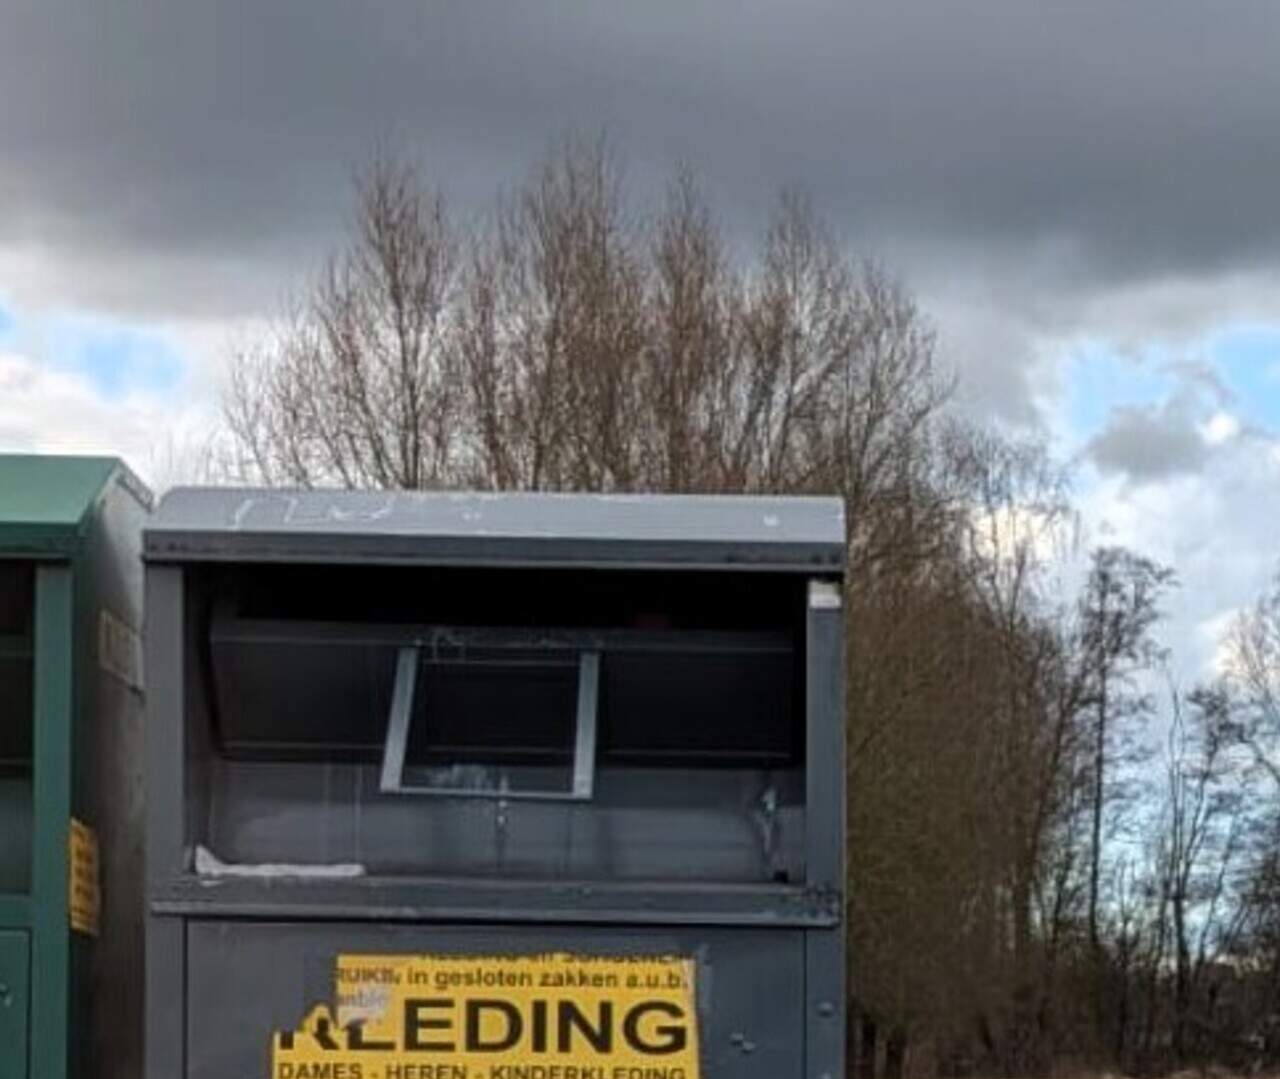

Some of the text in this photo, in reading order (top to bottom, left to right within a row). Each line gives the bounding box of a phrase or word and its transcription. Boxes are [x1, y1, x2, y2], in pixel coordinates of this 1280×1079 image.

[407, 967, 428, 985] in
[433, 966, 532, 990] gesloten
[539, 967, 618, 988] zakken
